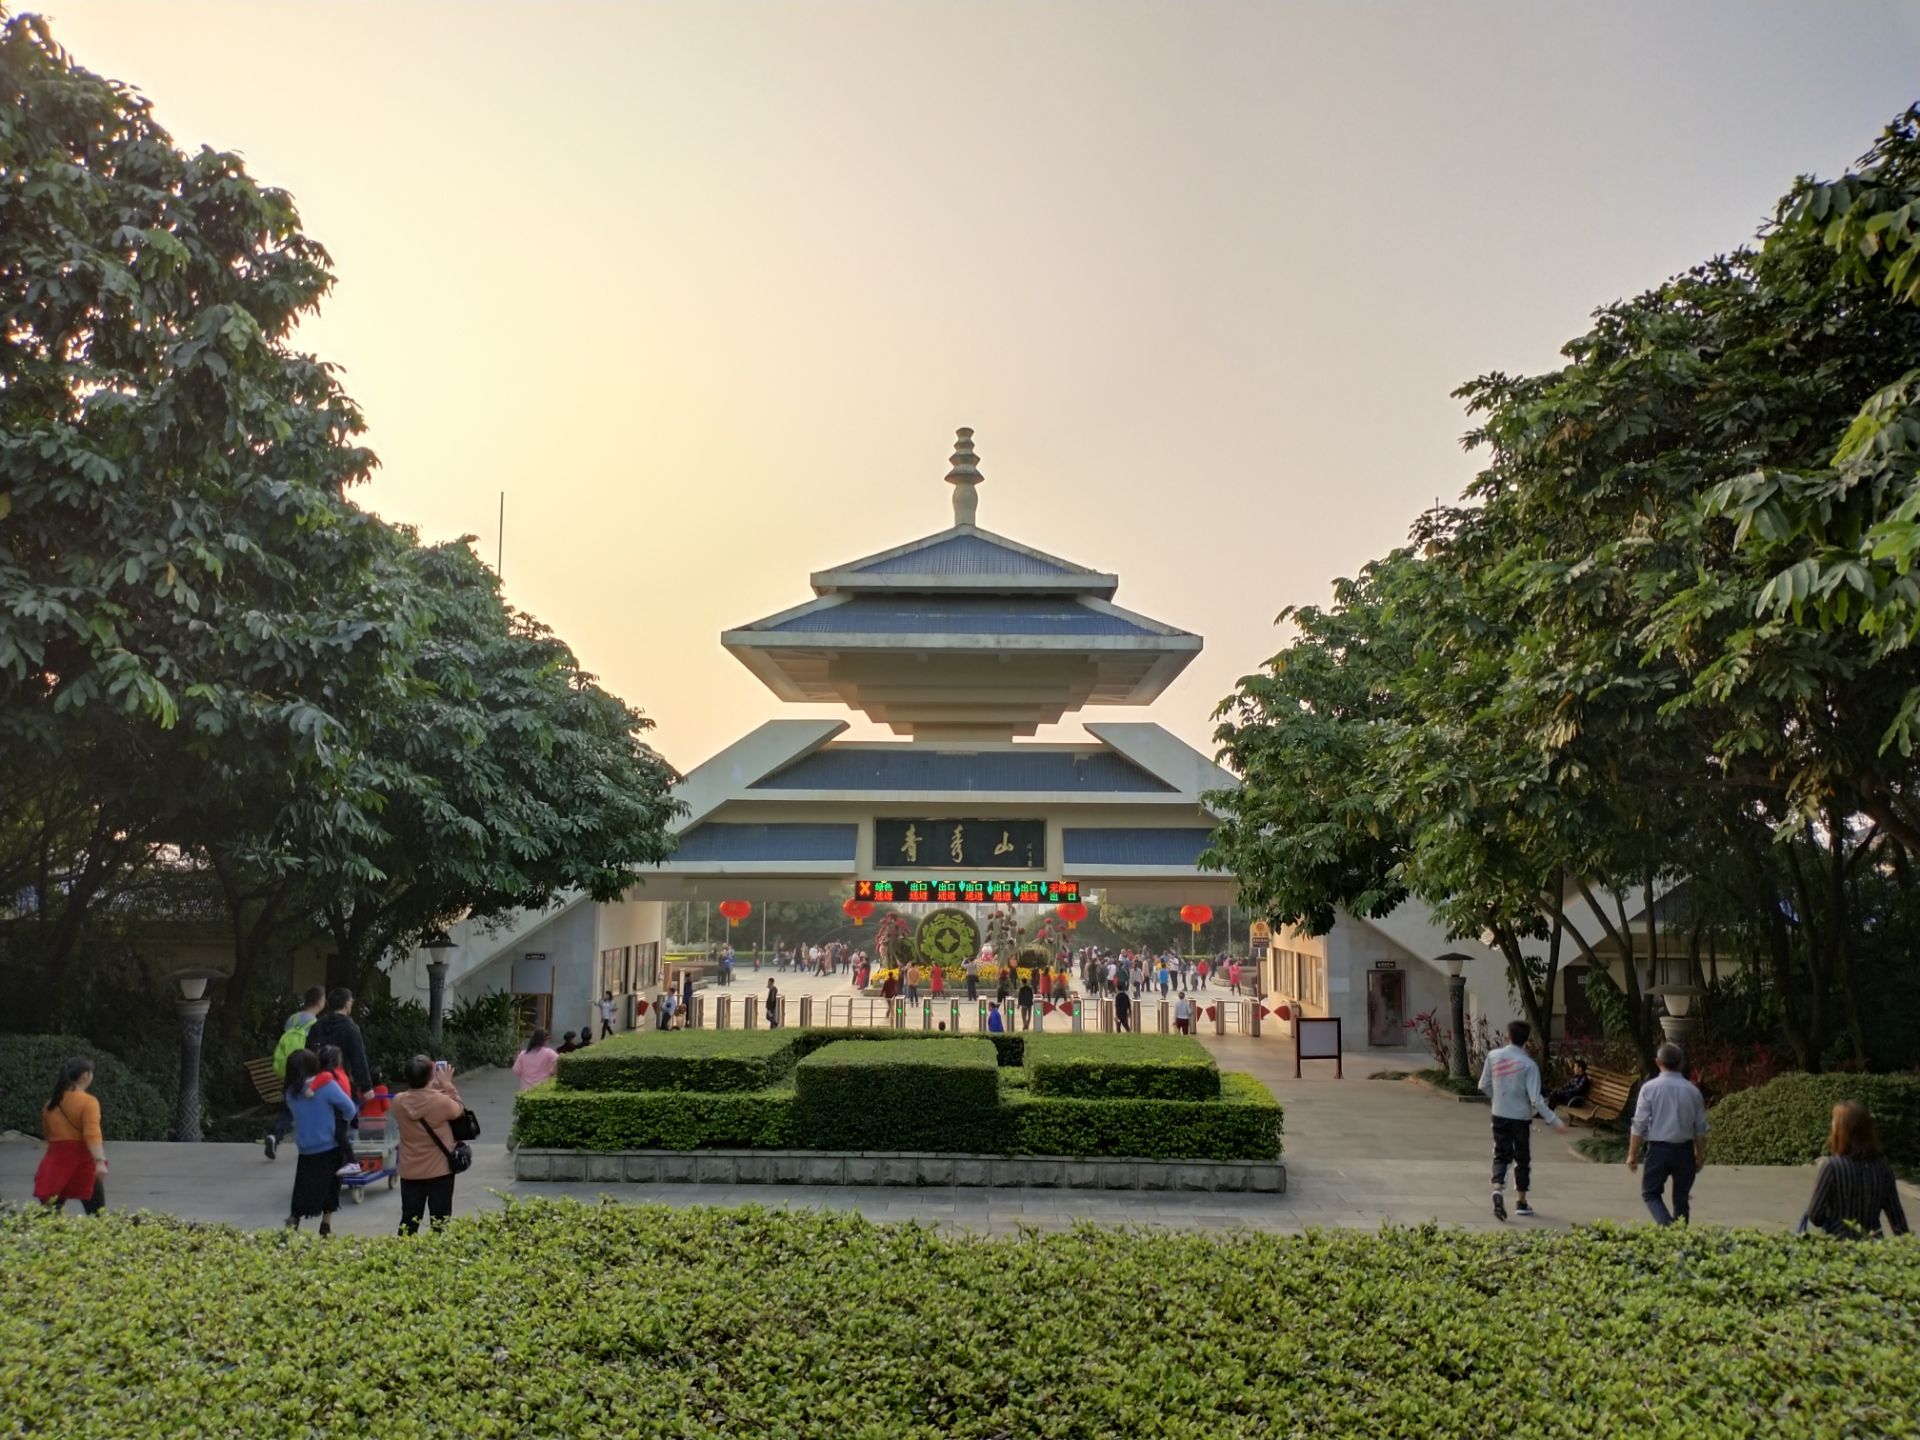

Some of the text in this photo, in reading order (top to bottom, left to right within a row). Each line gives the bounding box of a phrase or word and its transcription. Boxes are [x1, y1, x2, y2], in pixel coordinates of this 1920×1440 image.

[910, 883, 928, 891] 出口
[938, 883, 956, 891] 出口
[965, 883, 983, 891] 出口
[993, 883, 1011, 892] 出口
[1021, 883, 1038, 892] 出口
